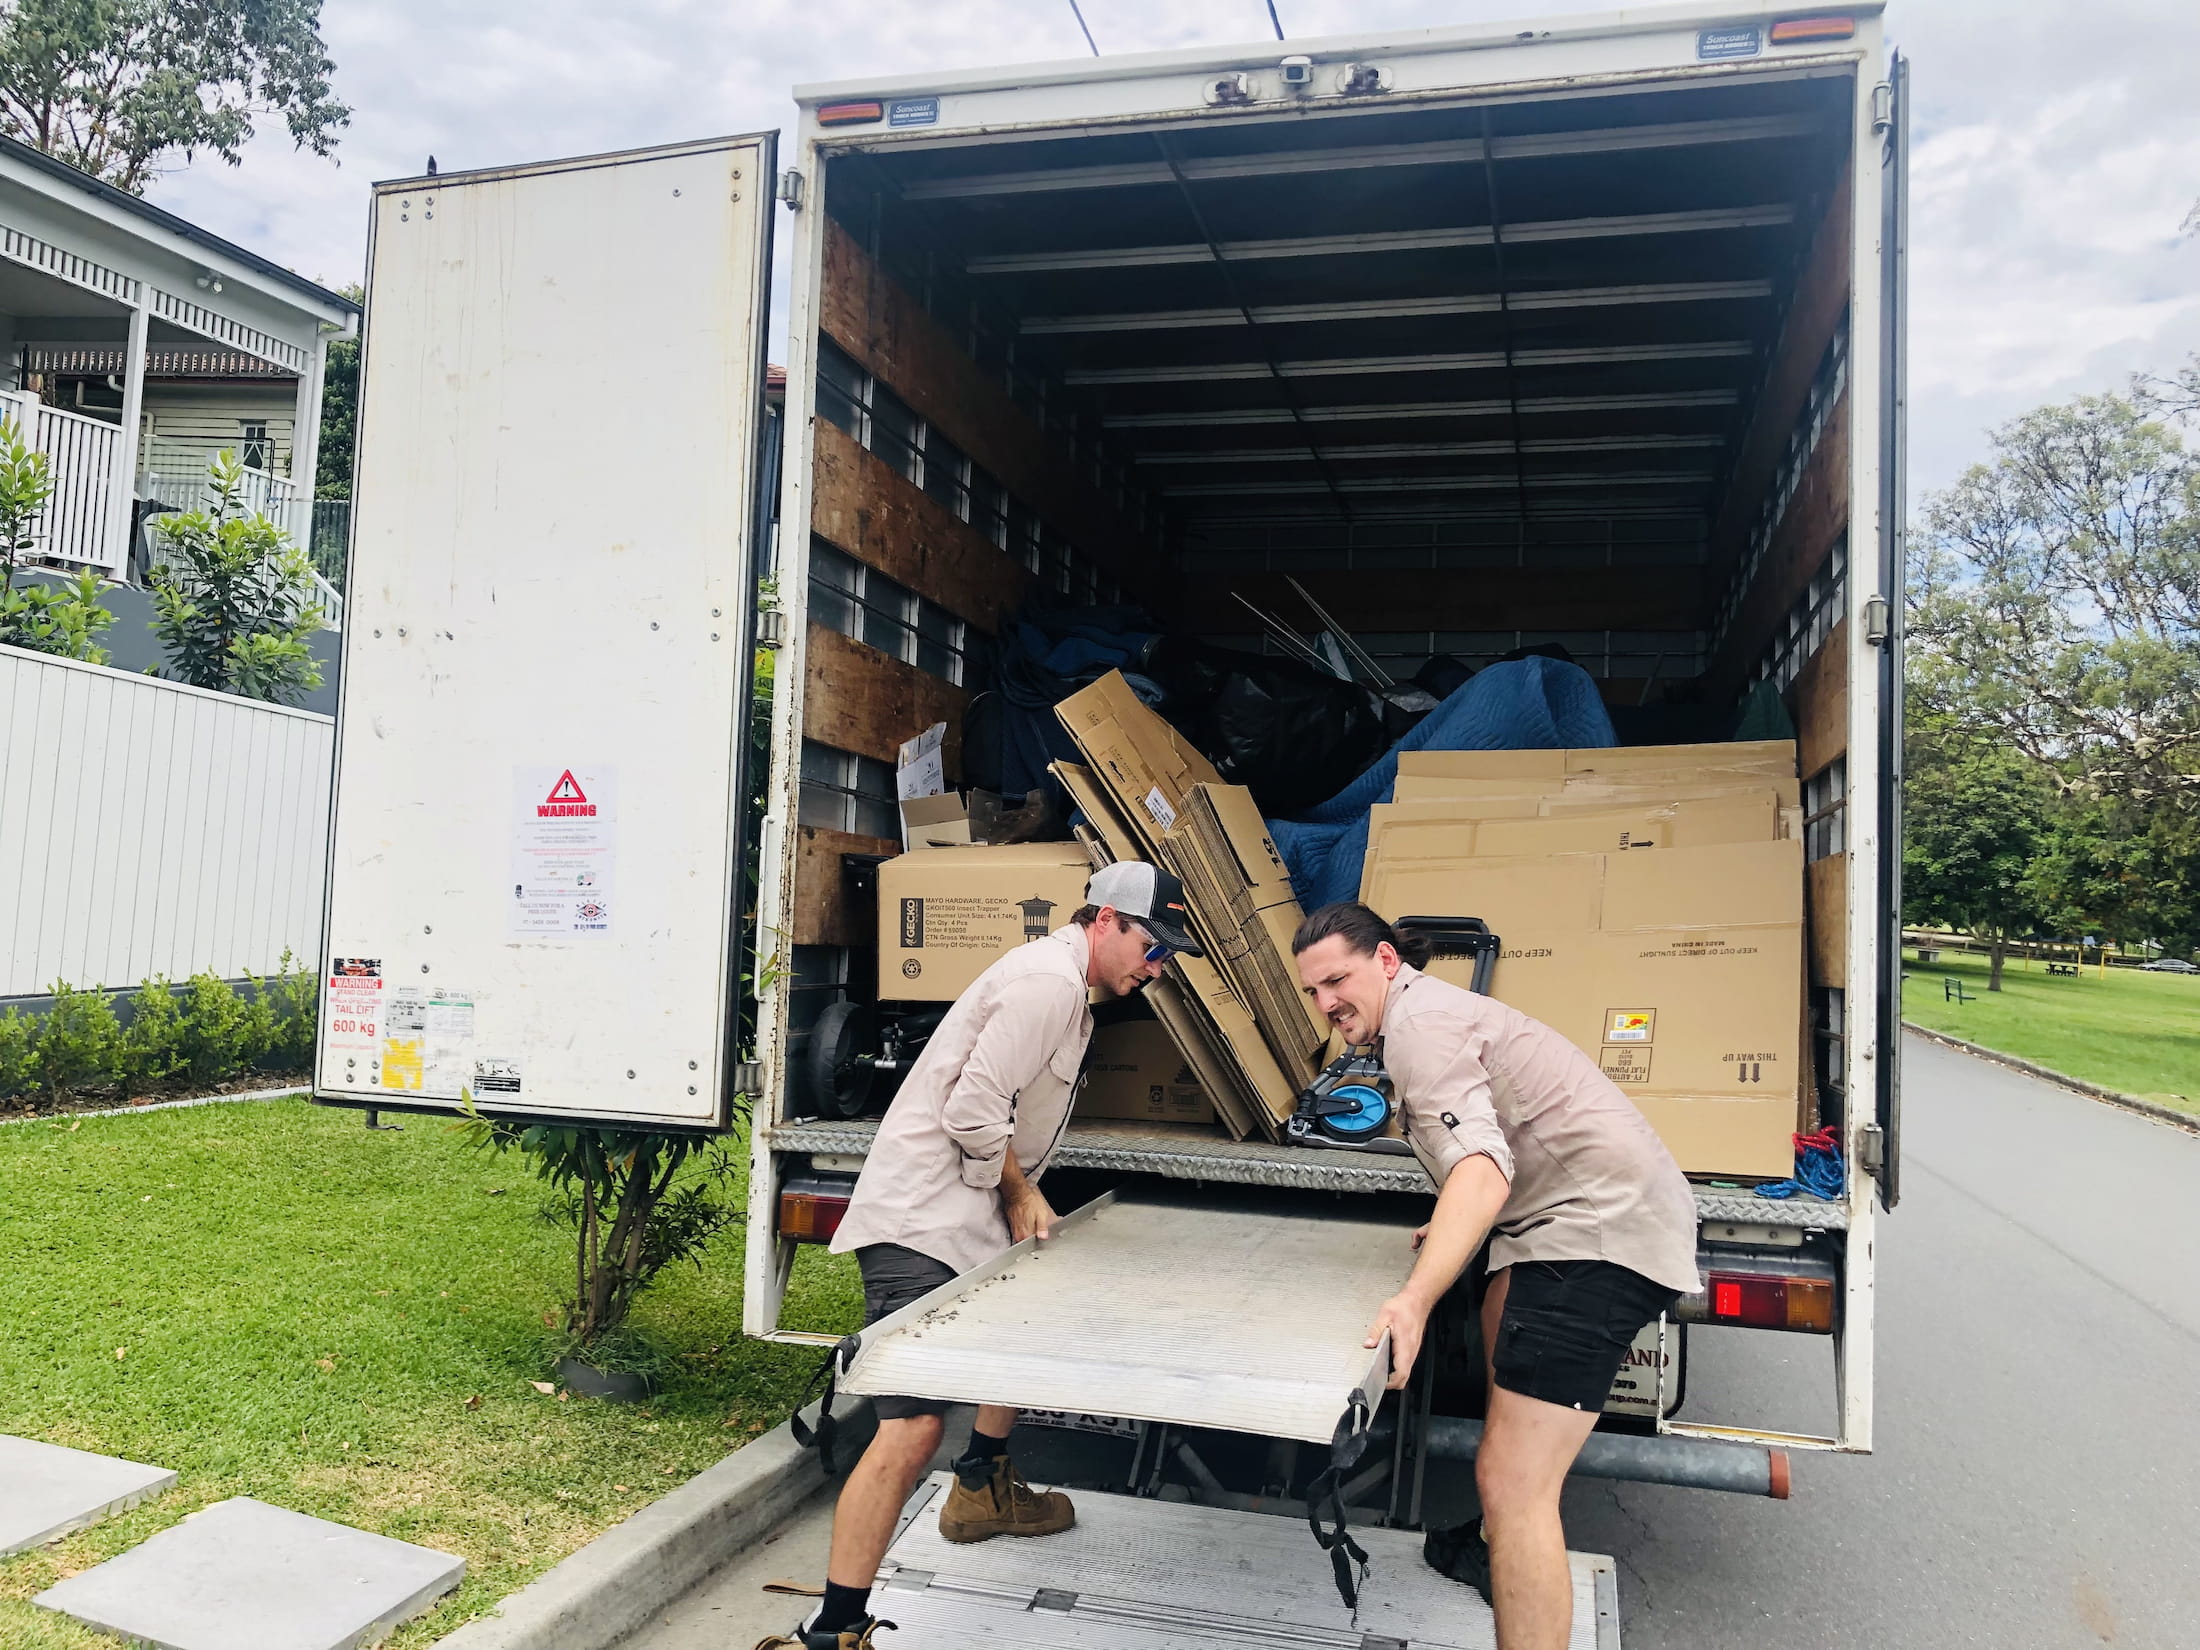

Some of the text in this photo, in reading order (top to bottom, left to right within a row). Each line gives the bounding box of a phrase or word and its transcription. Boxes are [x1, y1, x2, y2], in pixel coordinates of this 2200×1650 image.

[1706, 32, 1750, 44] Suncoast
[895, 104, 931, 113] Suncoast
[536, 804, 597, 817] WARNING
[1619, 831, 1630, 846] THIS
[976, 905, 1000, 913] Trapper
[906, 899, 916, 938] GECKO
[925, 941, 949, 949] Country
[1501, 949, 1523, 959] OUT
[1524, 948, 1553, 958] KEEP
[1639, 949, 1676, 958] SUNLIGHT
[1679, 949, 1706, 957] DIRECT
[335, 978, 378, 988] WARNING
[335, 1004, 375, 1015] TAIL LIFT
[333, 1020, 375, 1037] 600 kg
[1722, 1052, 1777, 1062] THIS WAY UP
[1602, 1066, 1646, 1074] FLAT PUNNET
